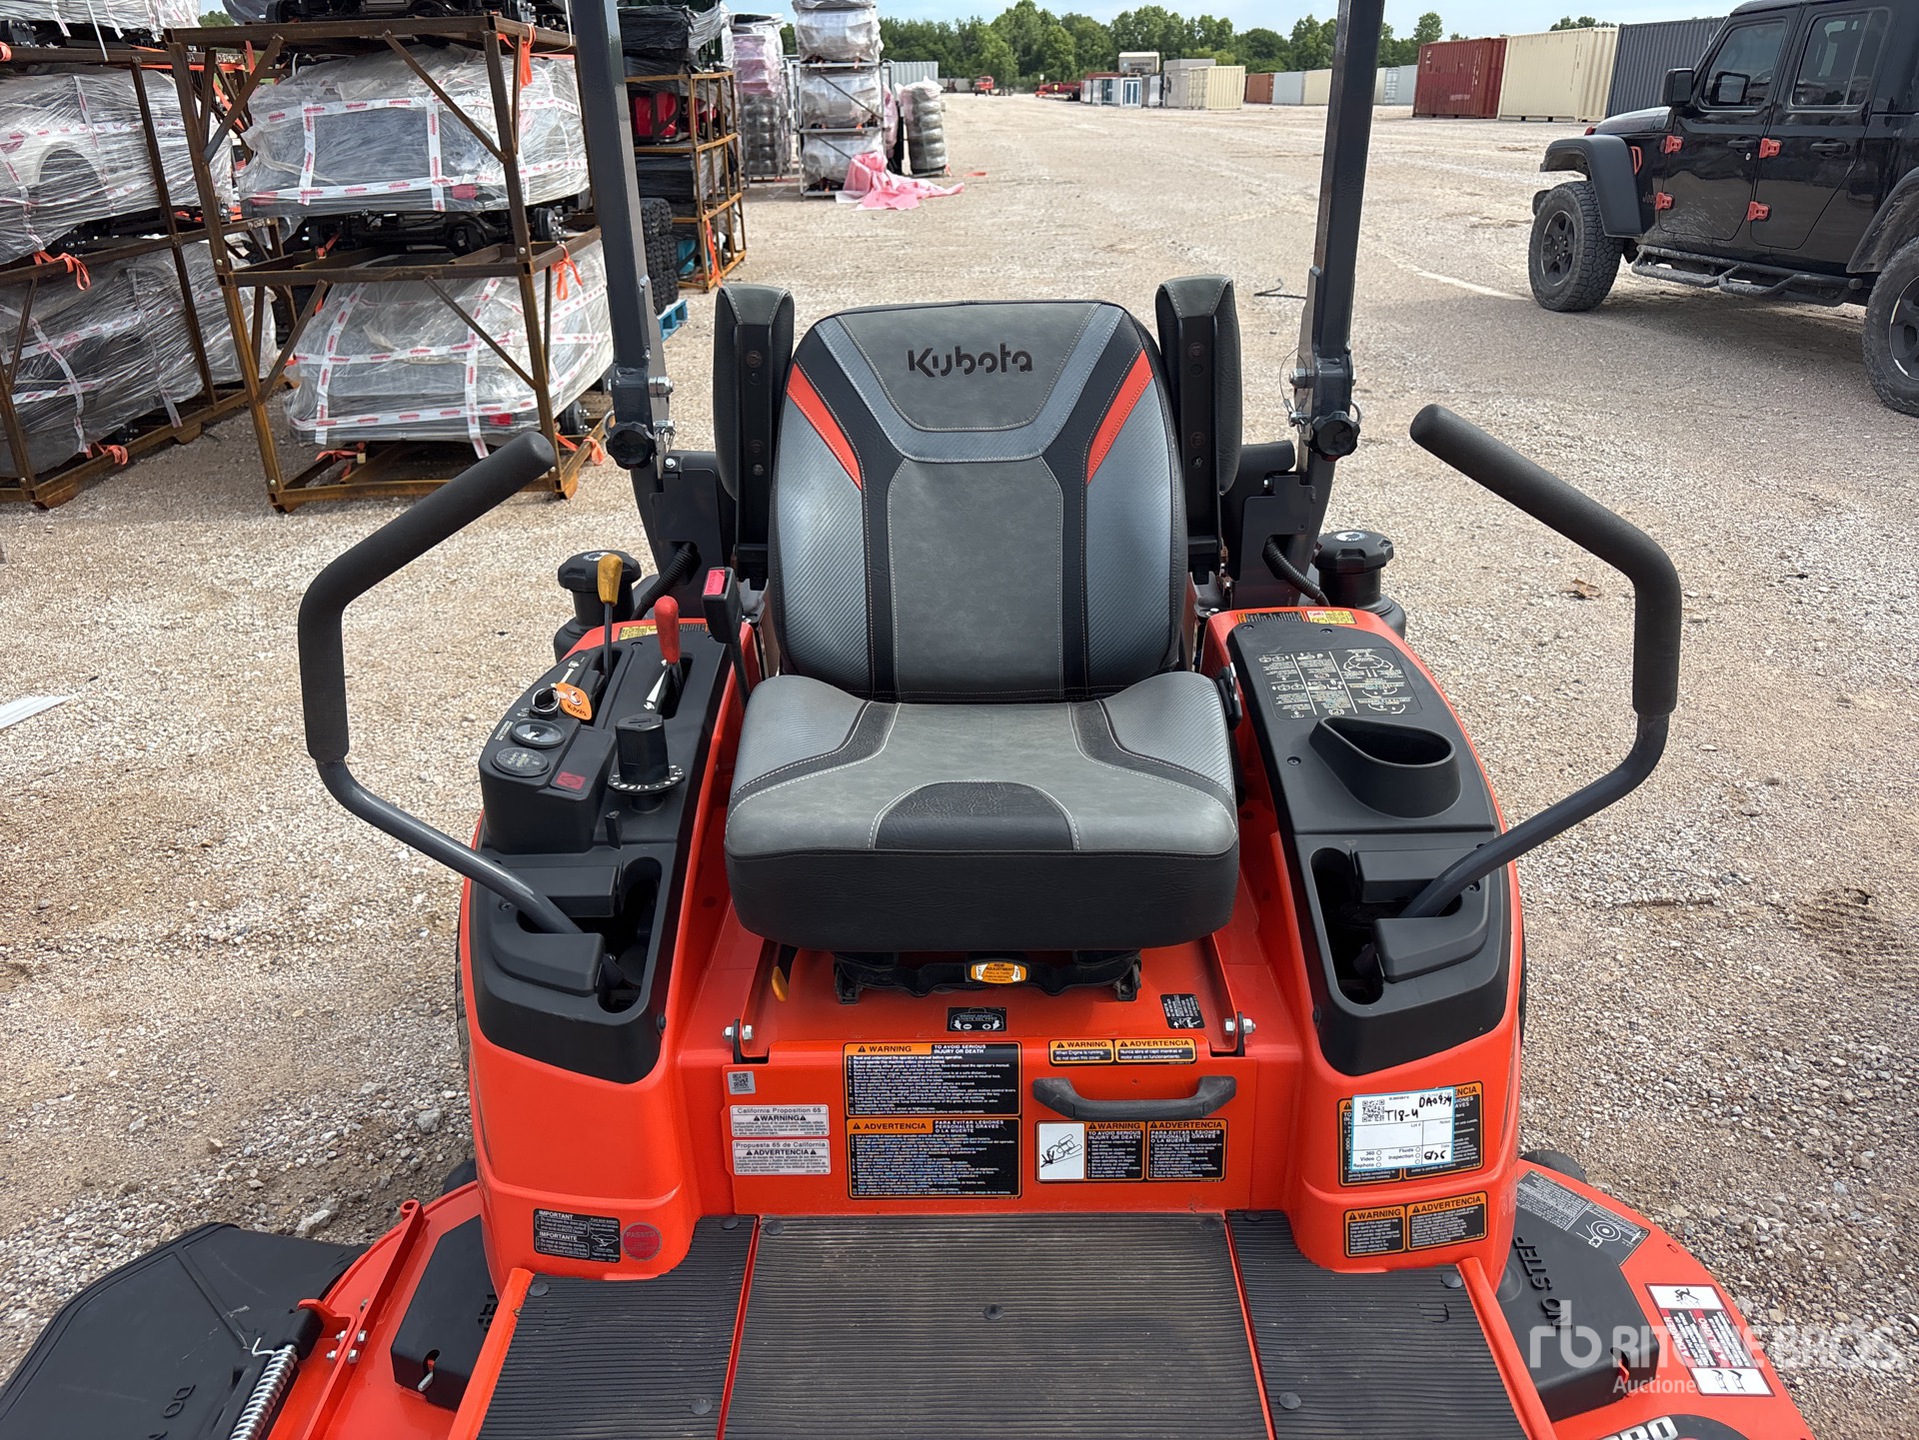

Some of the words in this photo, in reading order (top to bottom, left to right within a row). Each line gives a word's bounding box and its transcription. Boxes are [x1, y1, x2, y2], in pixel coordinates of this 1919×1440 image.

[907, 342, 1033, 378] Kubota
[539, 1210, 573, 1219] IMPORTANT
[1358, 1209, 1401, 1219] WARNING
[1421, 1196, 1481, 1212] ADVERTENCIA
[539, 1232, 577, 1242] IMPORTANTE
[1513, 1236, 1552, 1290] STEP
[1663, 1316, 1687, 1350] DANGER
[1698, 1318, 1725, 1353] PELIGRO
